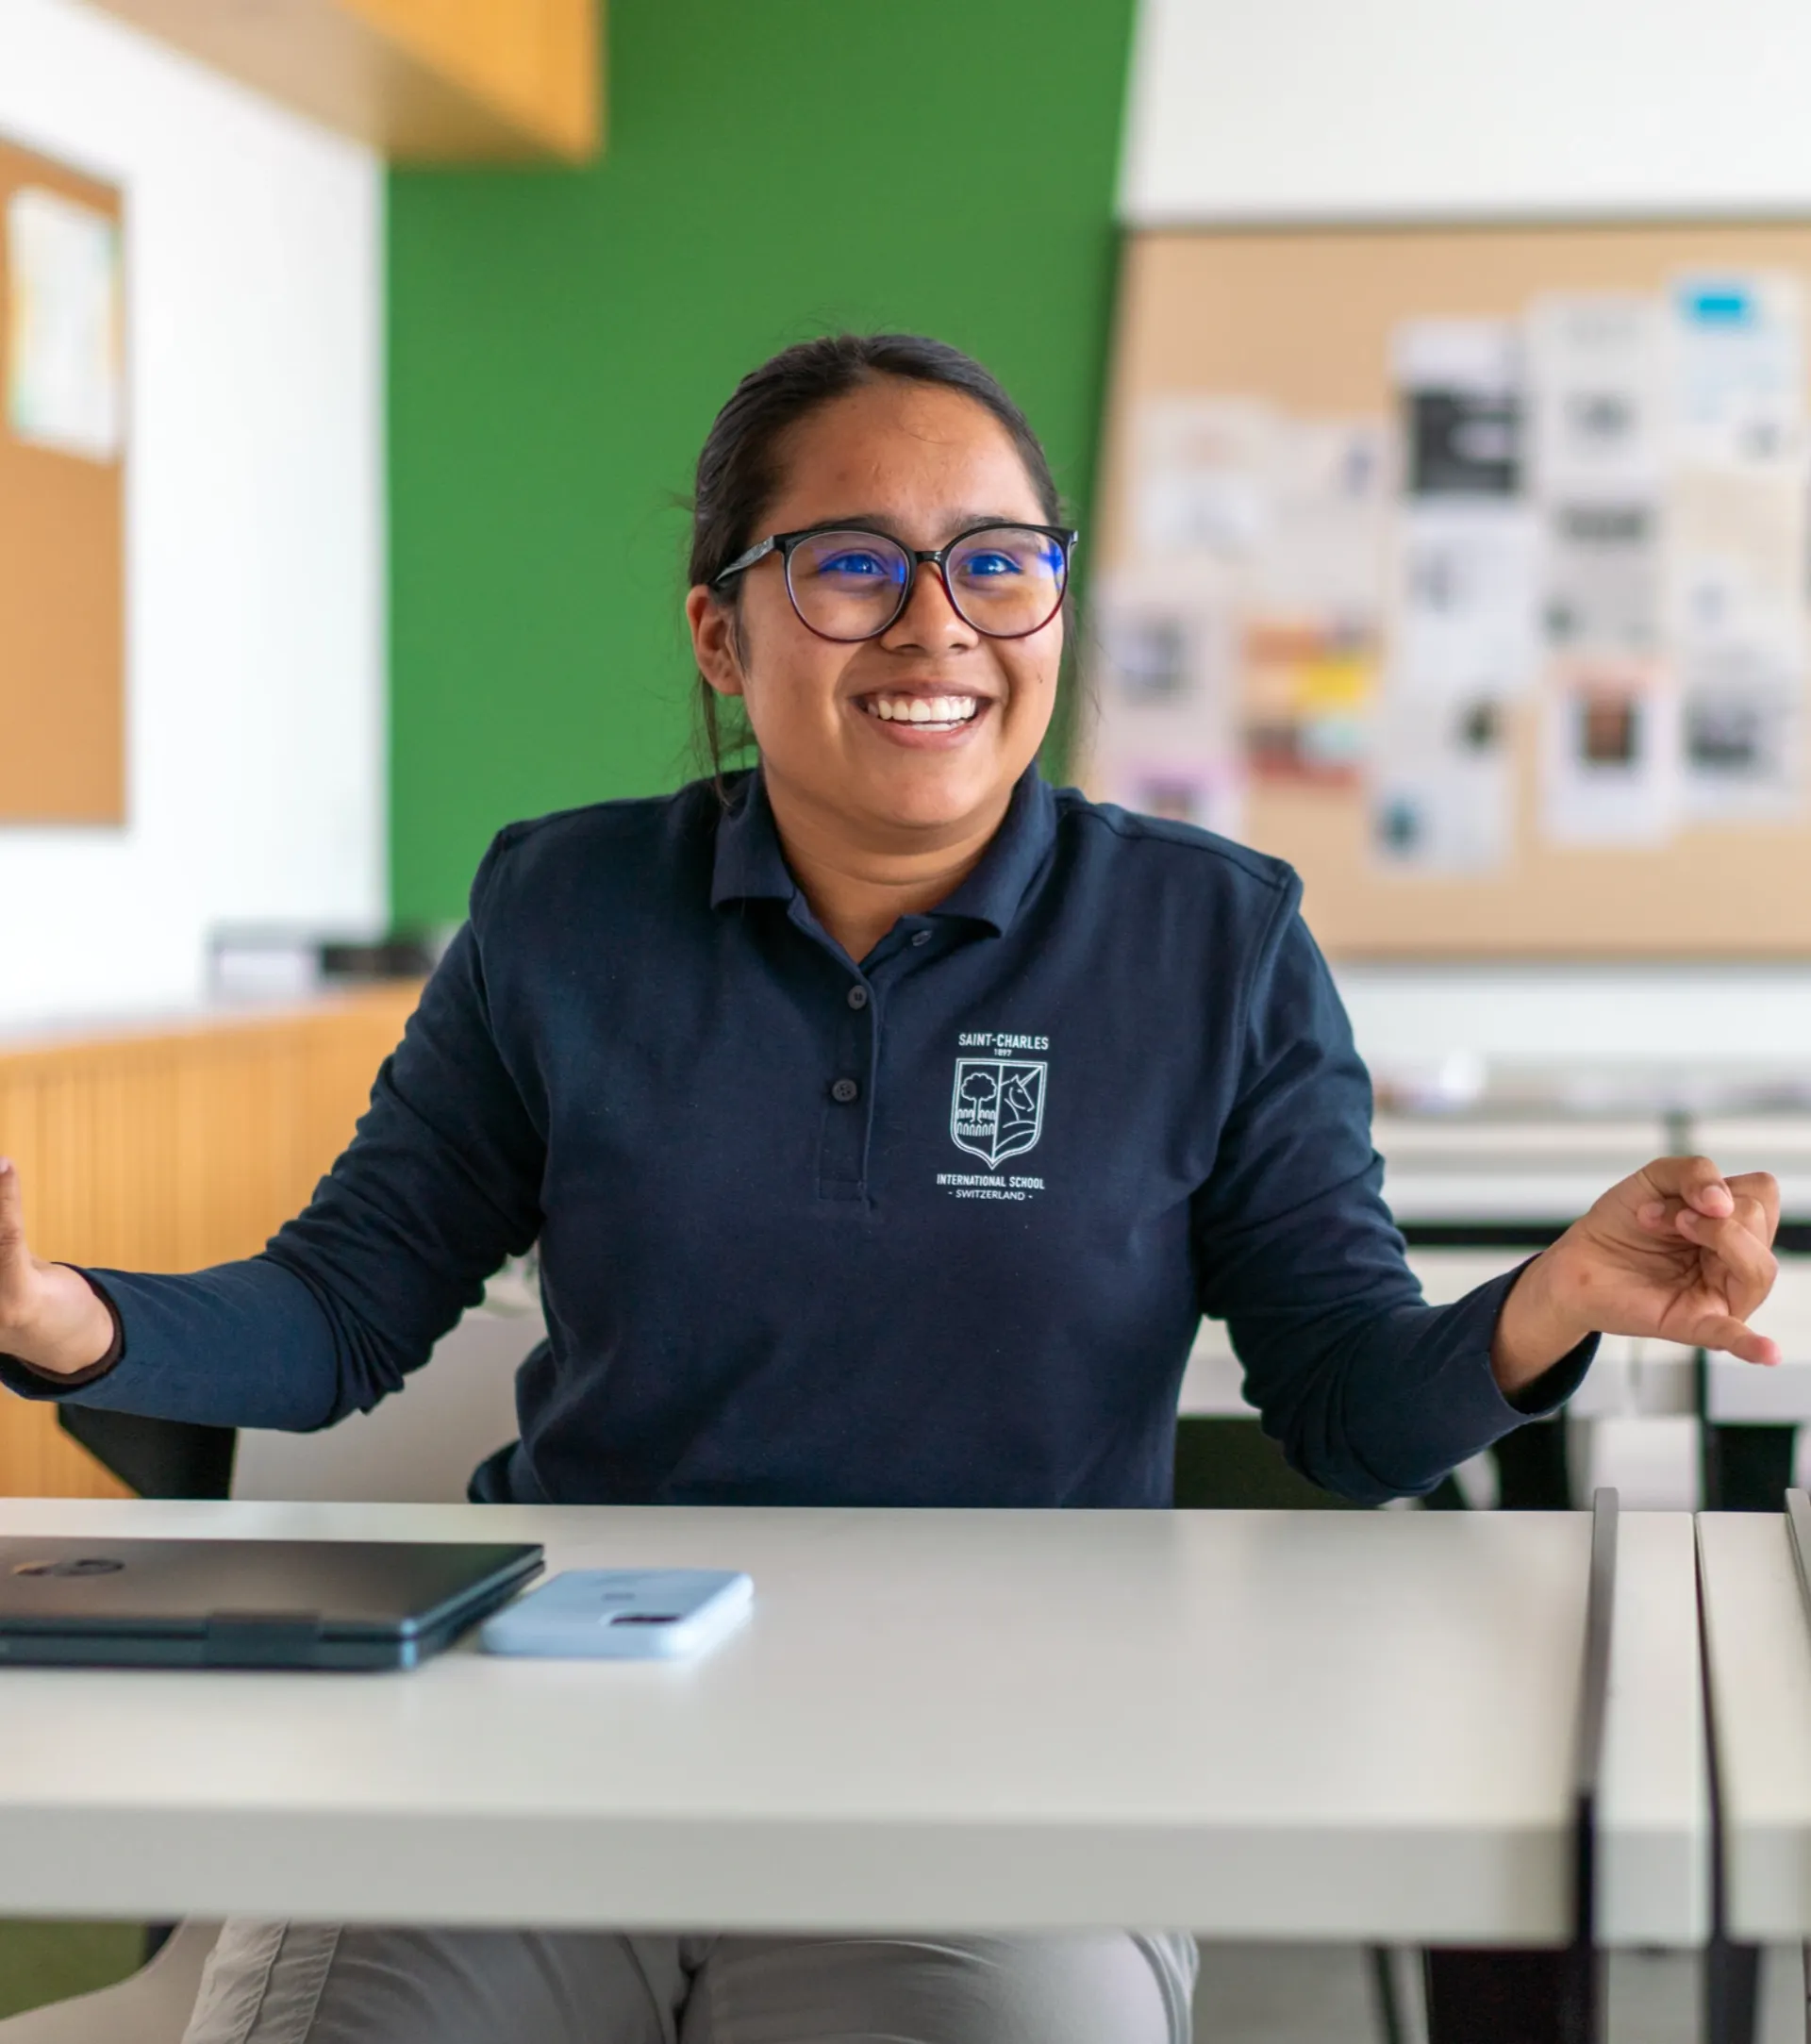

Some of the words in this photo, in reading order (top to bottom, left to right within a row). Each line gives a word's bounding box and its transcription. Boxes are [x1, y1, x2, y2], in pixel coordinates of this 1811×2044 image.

[958, 1033, 1049, 1050] SAINT-CHARLES
[937, 1173, 1005, 1188] INTERNATIONAL
[1009, 1176, 1045, 1189] SCHOOL
